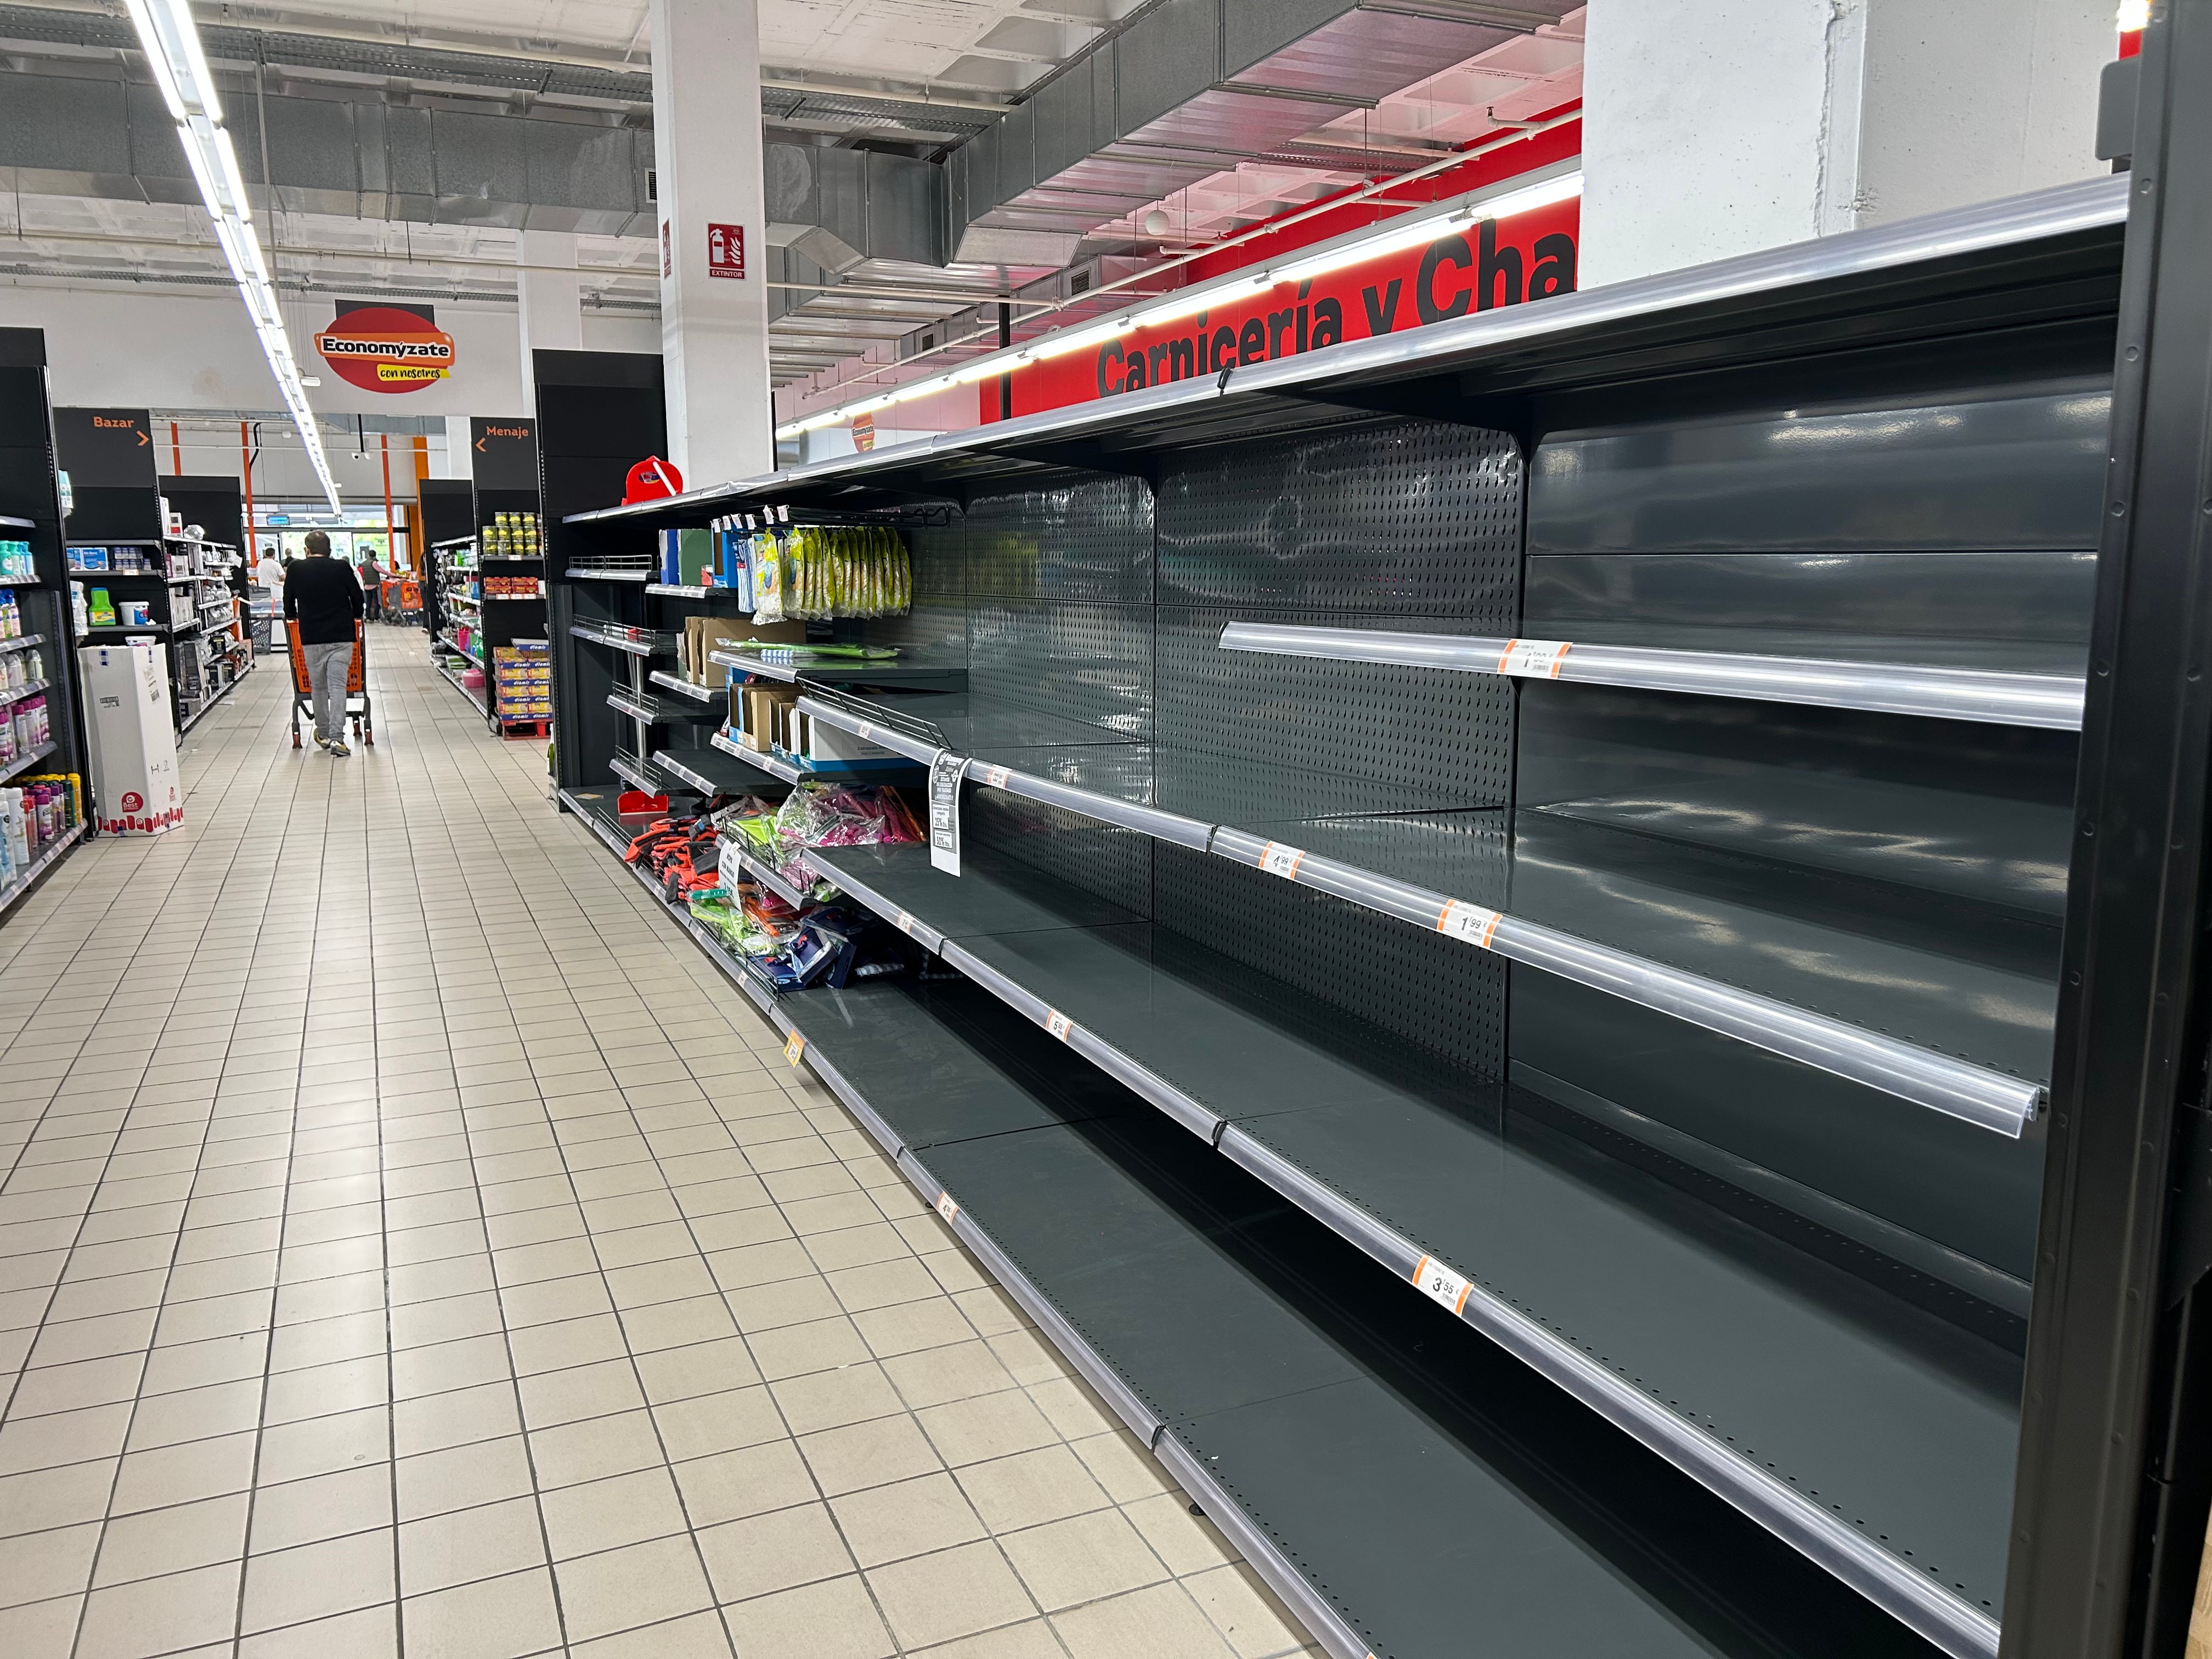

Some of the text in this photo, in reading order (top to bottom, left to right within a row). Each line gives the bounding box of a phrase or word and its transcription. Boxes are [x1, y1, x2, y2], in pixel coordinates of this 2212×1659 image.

[712, 269, 742, 278] EXTINTOR
[1097, 279, 1342, 398] Carnicería
[1417, 218, 1578, 325] Cha
[380, 369, 441, 379] con nosotros
[93, 416, 134, 428] Bazar
[486, 425, 529, 439] Menaje
[1432, 1277, 1455, 1294] 3'55
